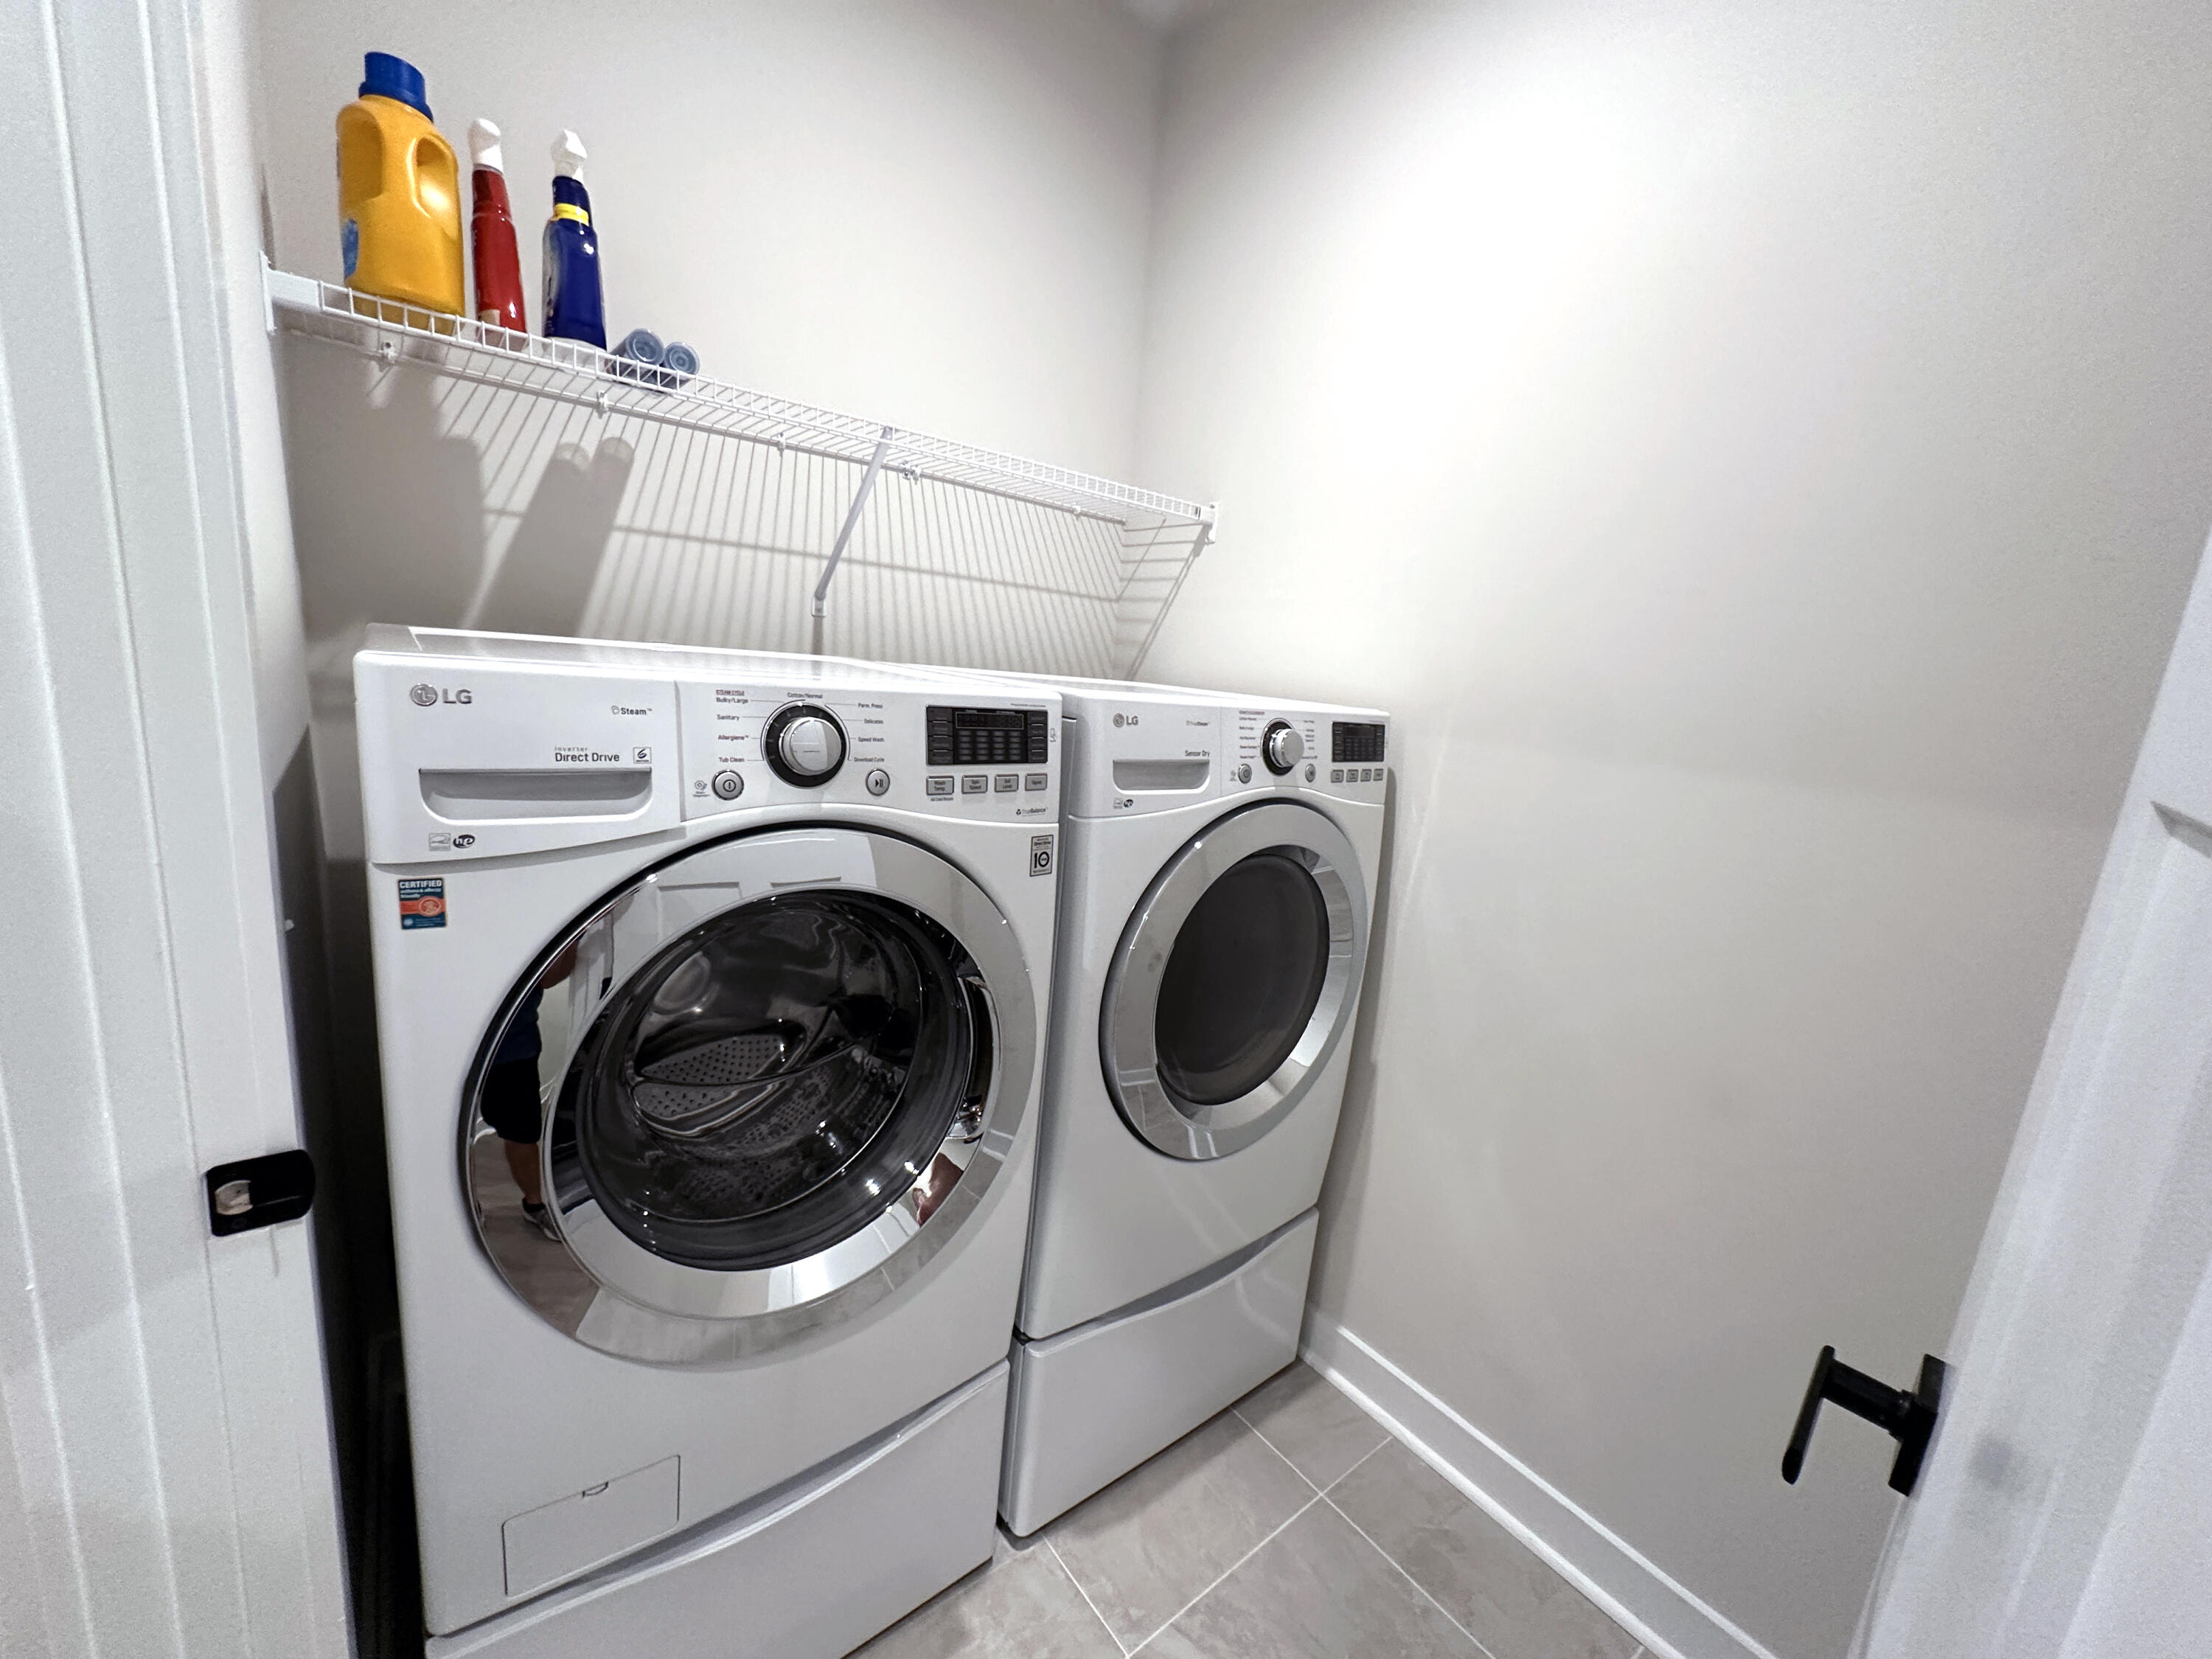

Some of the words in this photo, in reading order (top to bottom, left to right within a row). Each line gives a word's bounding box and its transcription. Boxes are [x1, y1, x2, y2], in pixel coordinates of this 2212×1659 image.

[442, 688, 473, 704] LG
[1126, 715, 1138, 726] LG
[555, 752, 589, 762] Direct
[591, 752, 620, 762] Drive
[1201, 750, 1210, 758] Dry
[1034, 851, 1050, 869] 10
[399, 880, 442, 889] CERTIFIED
